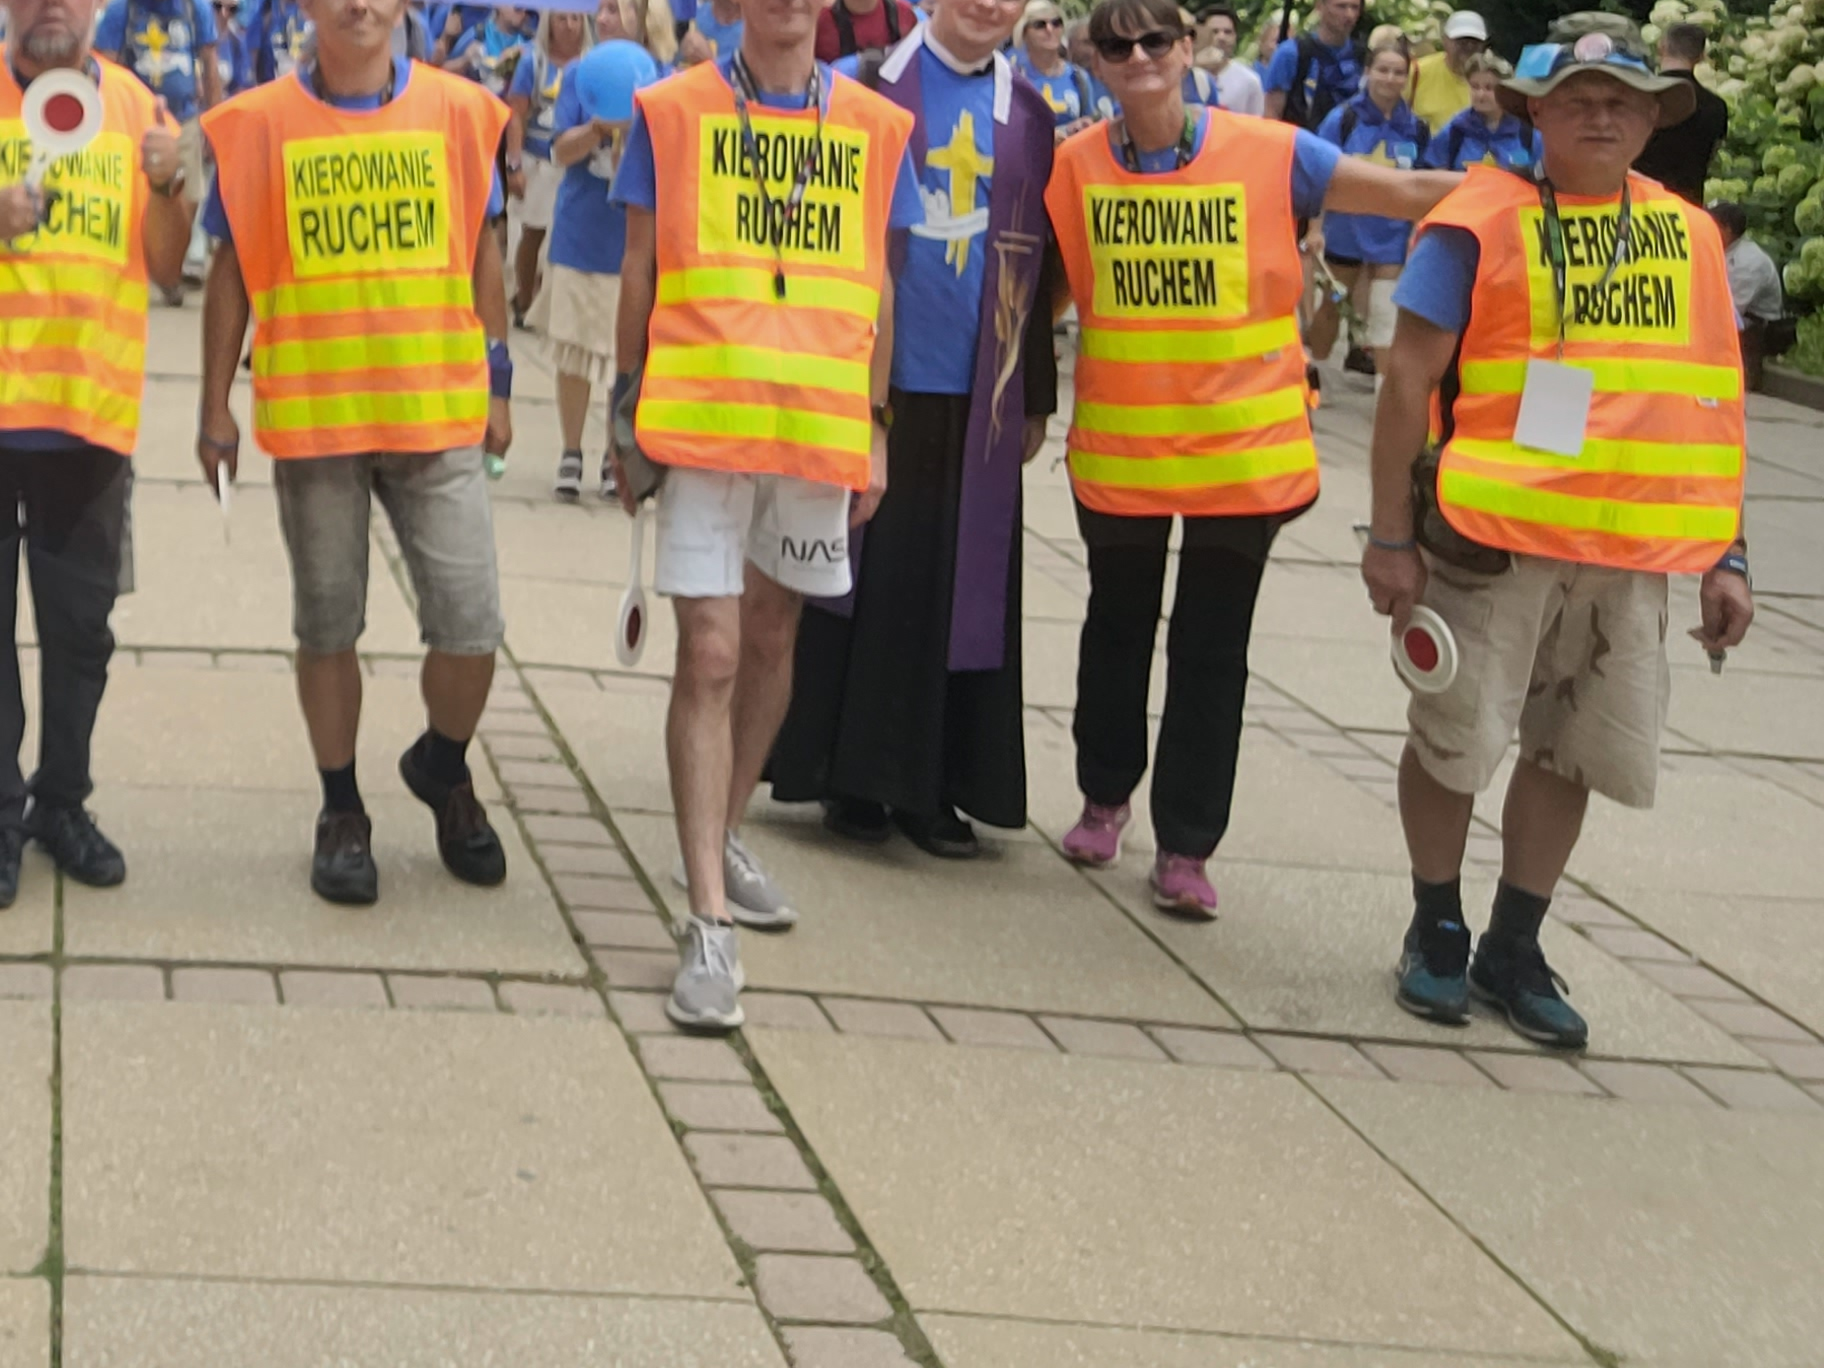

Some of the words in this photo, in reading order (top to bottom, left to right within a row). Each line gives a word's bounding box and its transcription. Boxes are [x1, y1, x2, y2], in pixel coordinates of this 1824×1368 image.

[292, 149, 435, 199] KIEROWANIE
[713, 128, 860, 194] KIEROWANIE
[42, 189, 122, 248] CHEM
[300, 198, 435, 259] RUCHEM
[737, 193, 841, 252] RUCHEM
[1092, 197, 1238, 245] KIEROWANIE
[1112, 258, 1217, 307] RUCHEM
[1571, 274, 1676, 329] RUCHEM
